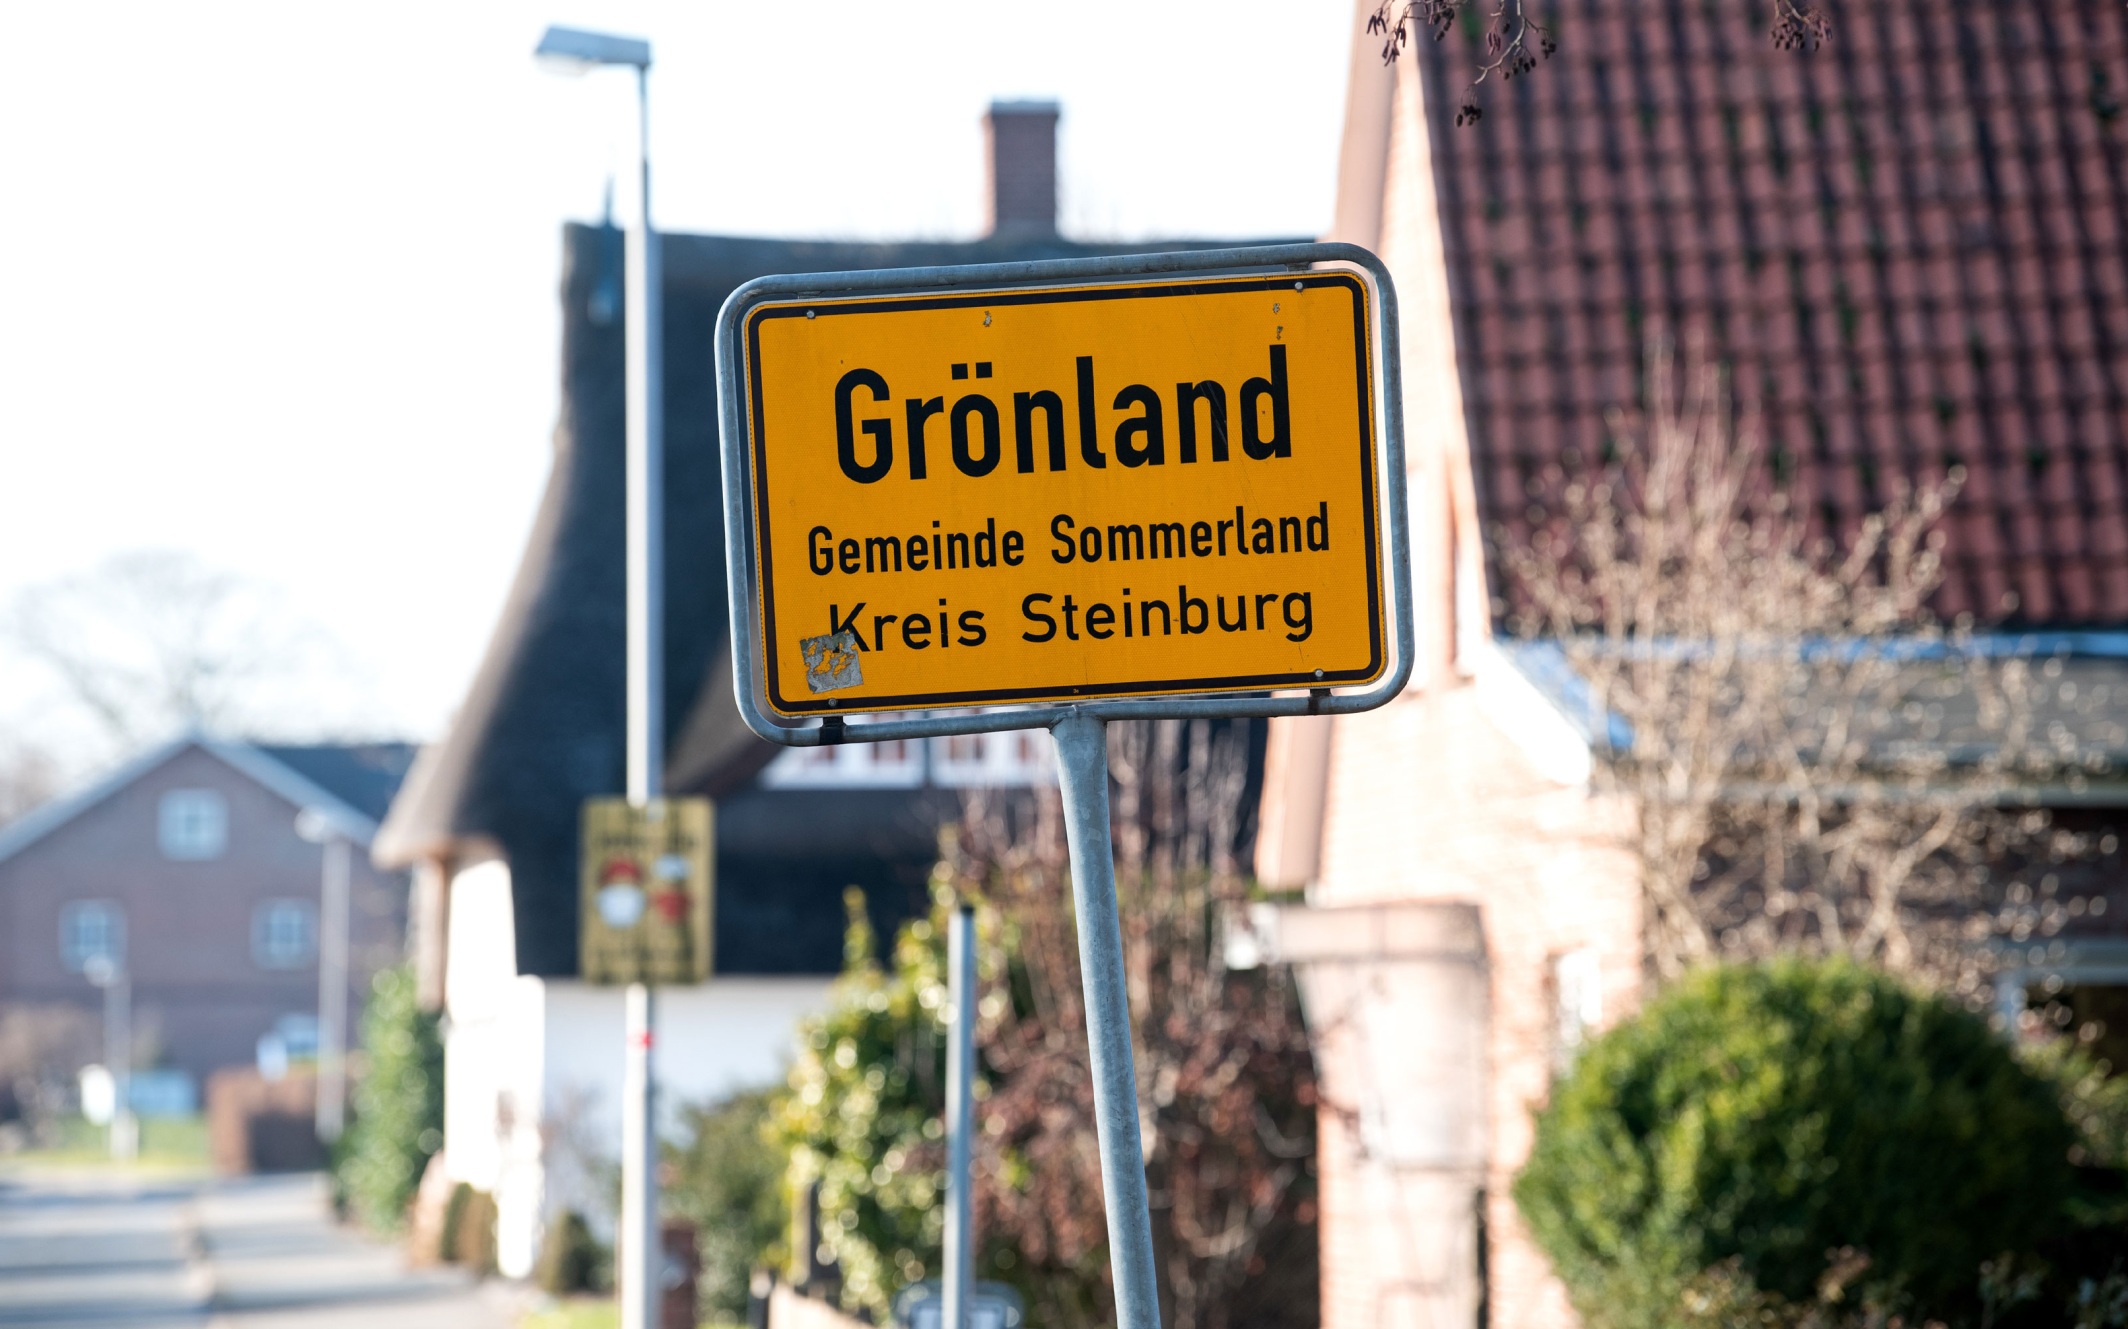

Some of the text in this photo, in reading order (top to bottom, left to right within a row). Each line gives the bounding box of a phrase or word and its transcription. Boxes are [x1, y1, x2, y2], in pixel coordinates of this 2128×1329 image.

[834, 343, 1292, 485] Grönland
[808, 501, 1330, 576] Gemeinde Sommerland
[829, 584, 1313, 653] Kreis Steinburg
